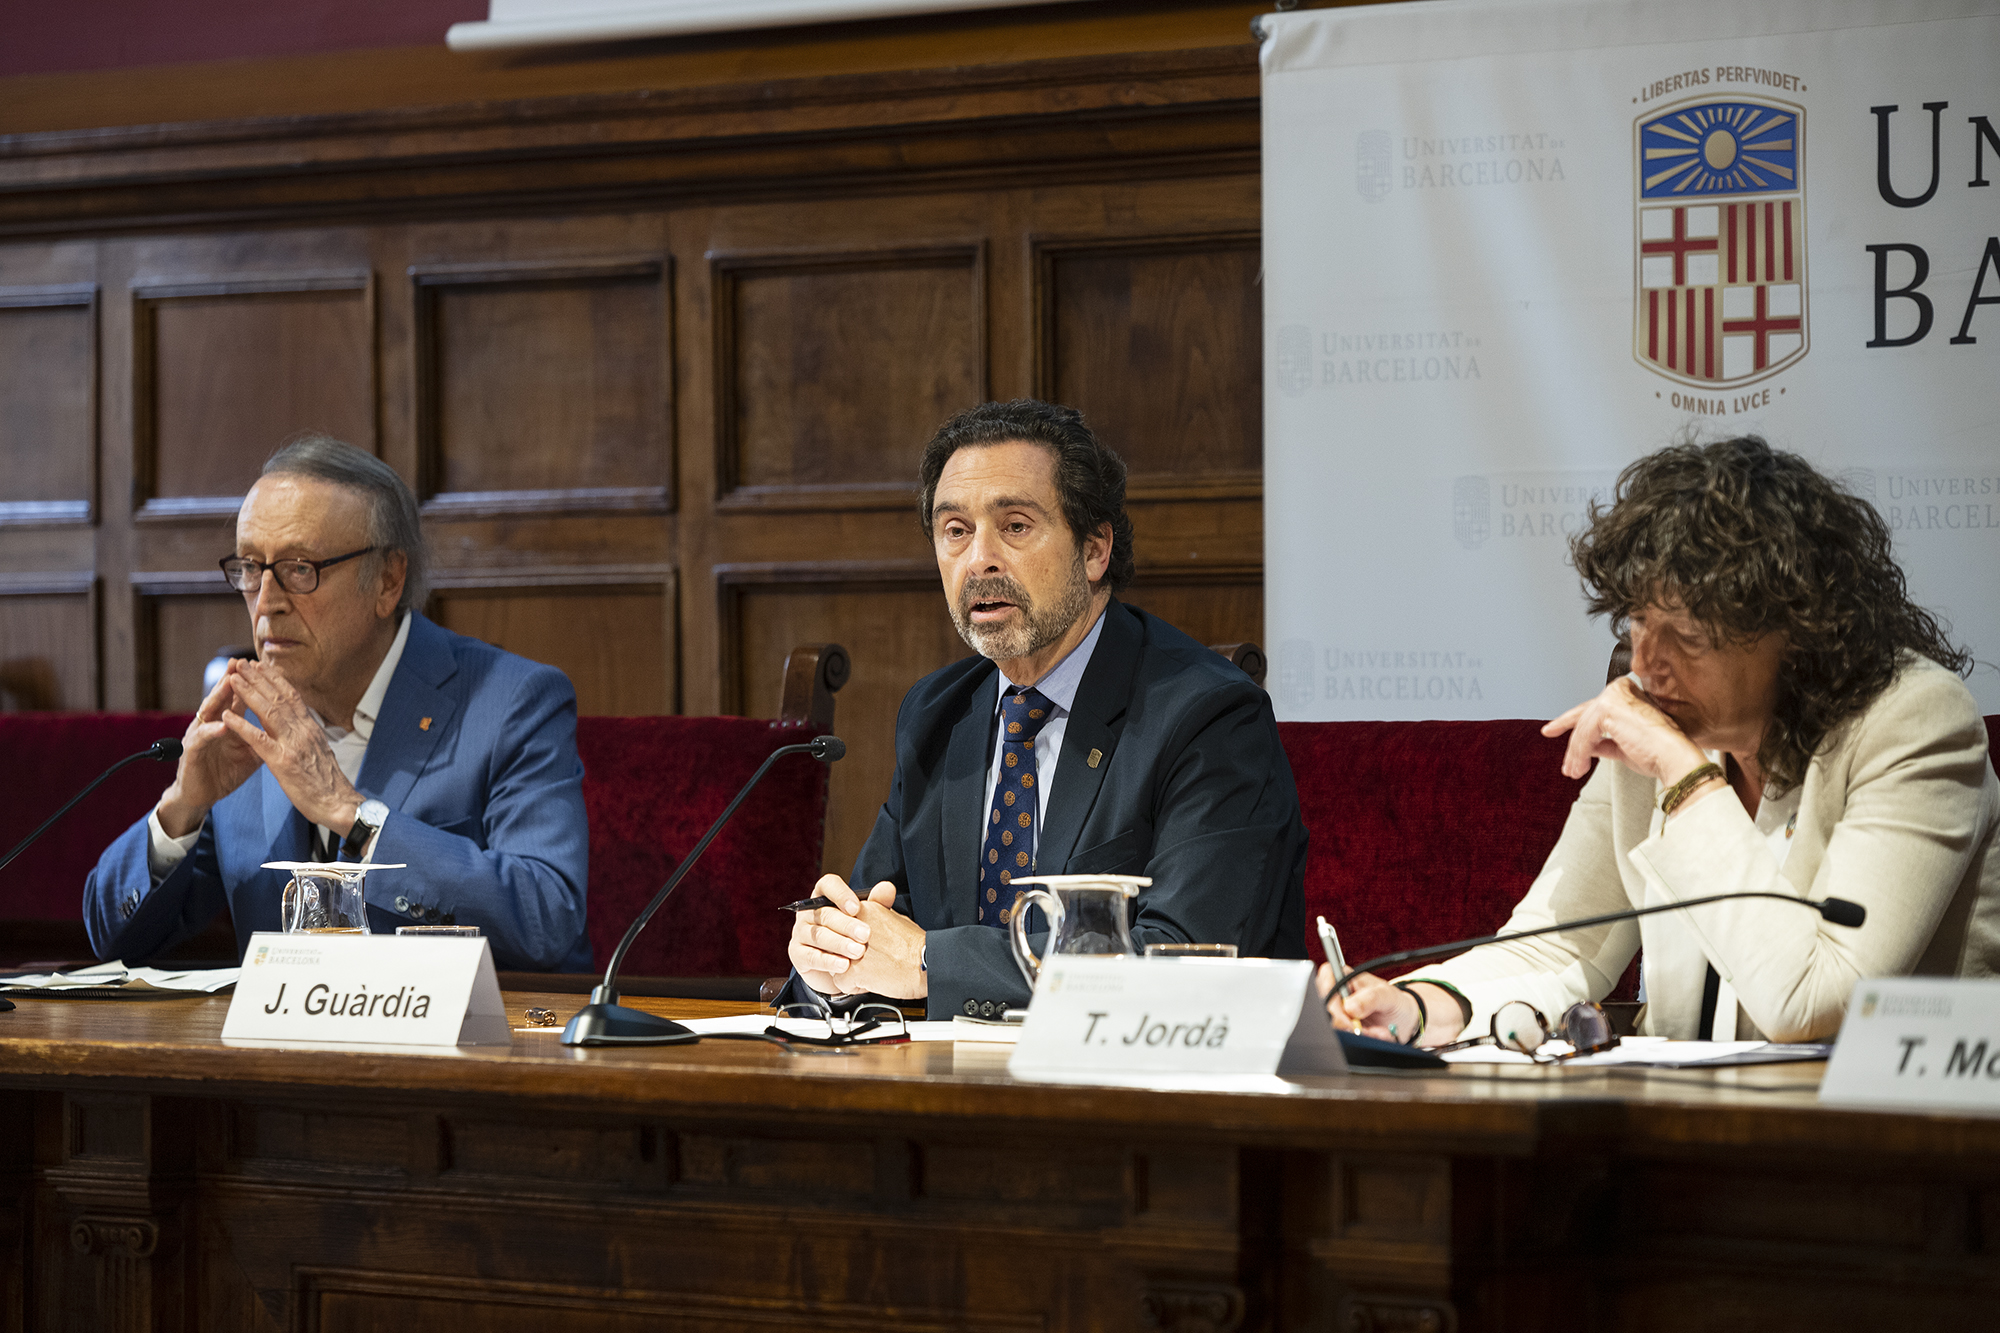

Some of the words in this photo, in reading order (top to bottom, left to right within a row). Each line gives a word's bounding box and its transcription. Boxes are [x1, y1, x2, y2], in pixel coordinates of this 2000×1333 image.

[1641, 68, 1710, 103] LIBERTAS
[1715, 66, 1801, 92] PERFVNDET
[1402, 132, 1549, 161] UNIVERSITAT
[1402, 157, 1566, 190] BARCELONA
[1865, 236, 2000, 349] BA
[1321, 331, 1464, 357] UNIVERSITAT
[1321, 354, 1482, 384] BARCELONA
[1671, 391, 1727, 417] OMNIA
[1733, 388, 1771, 414] LVCE
[1889, 503, 2000, 530] BARCEL
[1324, 648, 1467, 672] UNIVERSITAT
[1324, 675, 1484, 701] BARCELONA
[264, 982, 289, 1015] J.
[304, 983, 431, 1019] Guàrdia
[1083, 1012, 1109, 1046] T.
[1122, 1013, 1231, 1048] Jordà
[1898, 1036, 1926, 1077] T.
